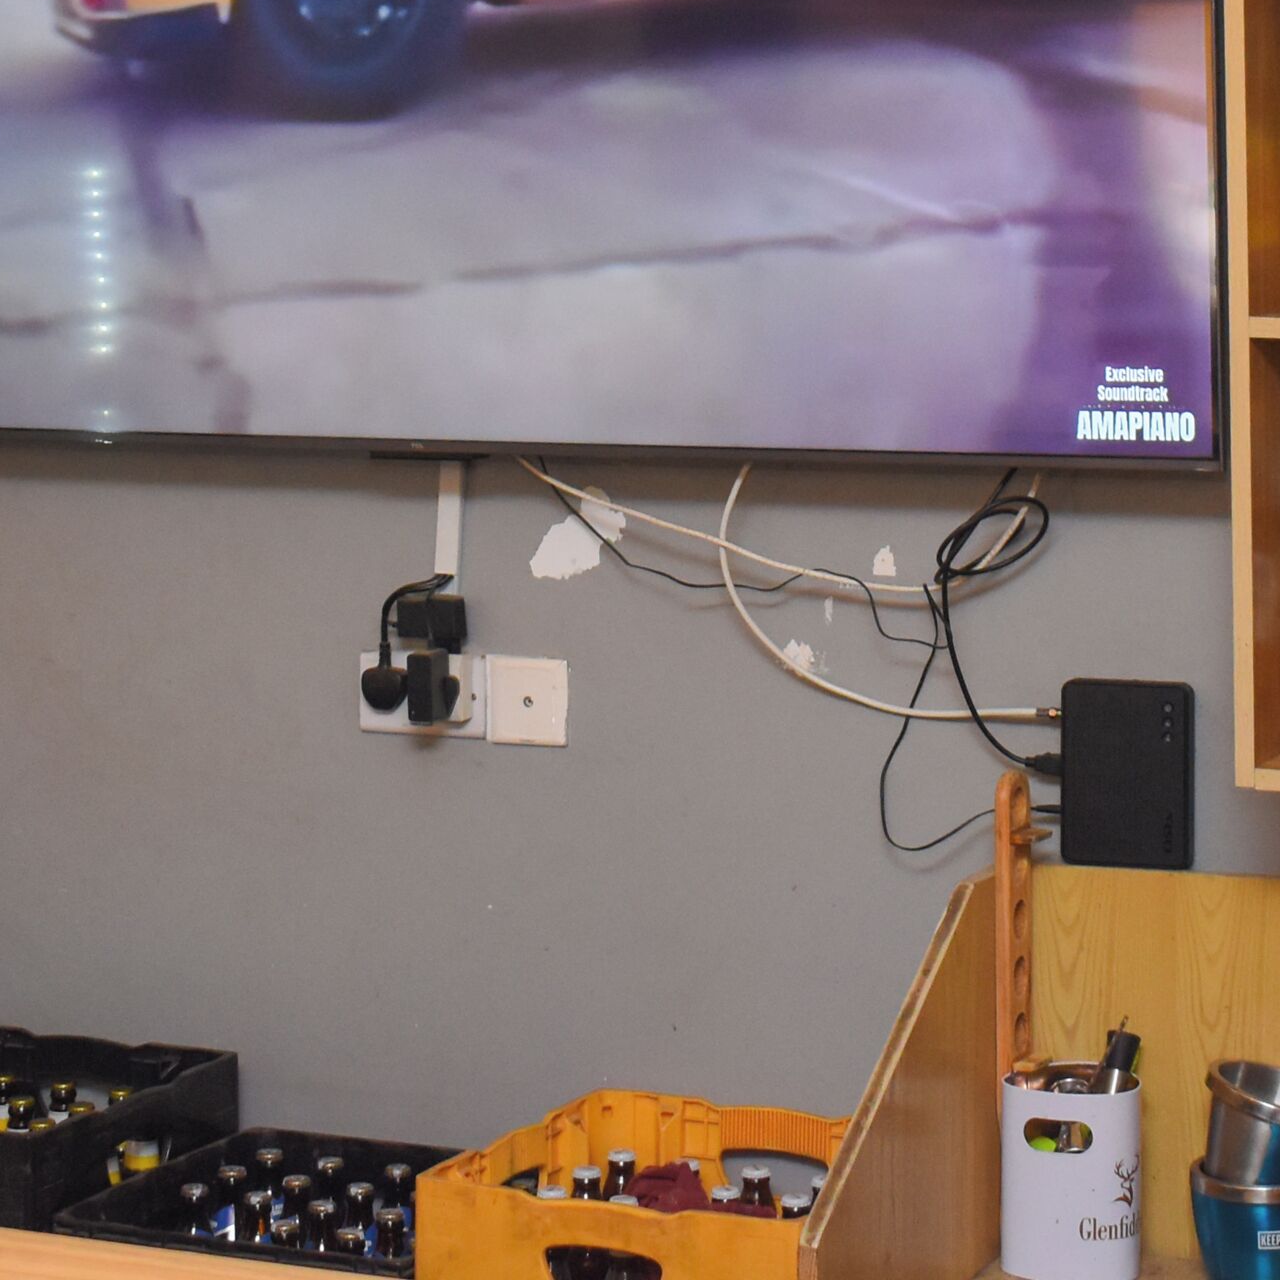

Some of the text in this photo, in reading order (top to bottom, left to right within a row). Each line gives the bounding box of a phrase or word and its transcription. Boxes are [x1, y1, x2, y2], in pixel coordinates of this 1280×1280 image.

[1105, 365, 1164, 383] Exclusive
[1097, 384, 1169, 402] Soundtrack
[1076, 410, 1196, 442] AMAPIANO
[1079, 1216, 1140, 1242] Glenfid
